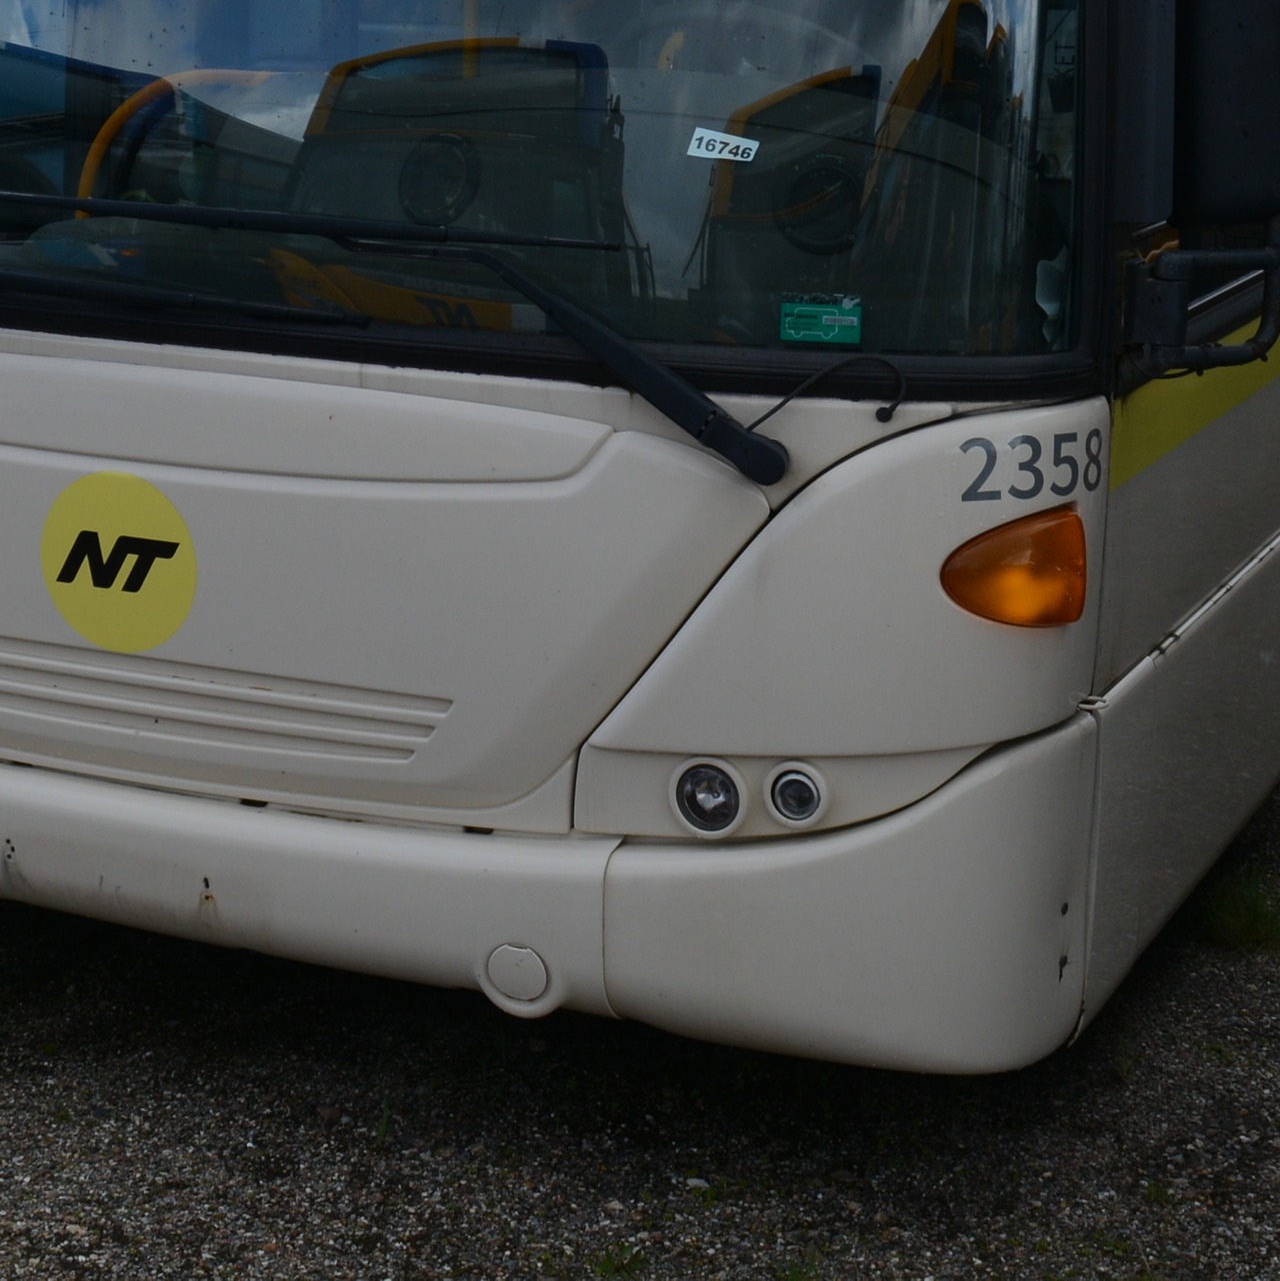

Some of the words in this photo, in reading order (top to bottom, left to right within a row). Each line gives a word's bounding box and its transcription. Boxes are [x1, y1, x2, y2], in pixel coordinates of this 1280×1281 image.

[694, 135, 753, 160] 16746
[959, 428, 1103, 502] 2358
[56, 530, 180, 592] NT
